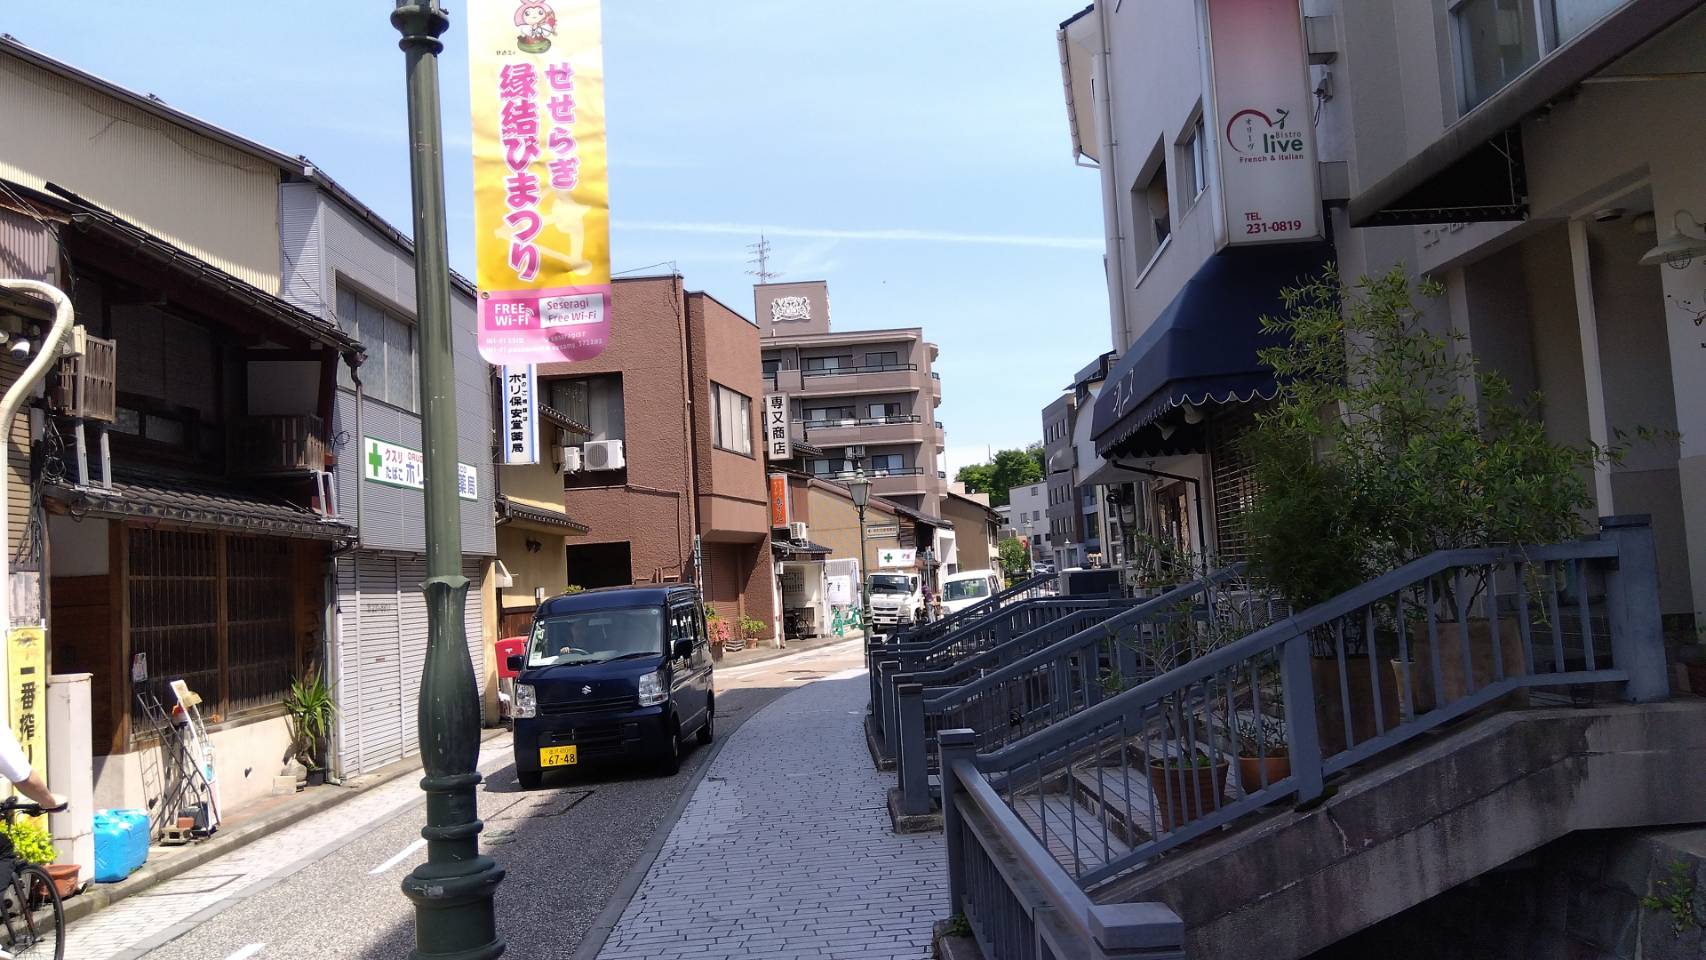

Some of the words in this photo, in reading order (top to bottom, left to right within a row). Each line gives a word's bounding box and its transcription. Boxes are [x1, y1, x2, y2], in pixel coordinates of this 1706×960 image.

[545, 63, 578, 189] せせらぎ
[1276, 131, 1302, 139] Bistro
[1240, 155, 1268, 163] French
[1278, 153, 1304, 161] Italian
[500, 64, 543, 281] 縁結びまつり
[1245, 212, 1261, 221] TEL
[1246, 220, 1301, 234] 231-0819
[495, 303, 525, 315] FREE
[547, 298, 588, 311] Seseragi
[495, 314, 529, 327] Wi-Fi
[548, 314, 570, 324] Free
[571, 310, 597, 321] Wi-Fi
[509, 373, 524, 454] ホリ保安堂薬局
[770, 396, 786, 455] 専又商店
[385, 448, 404, 464] クスリ
[385, 466, 404, 481] たばこ
[549, 754, 575, 764] 67-48
